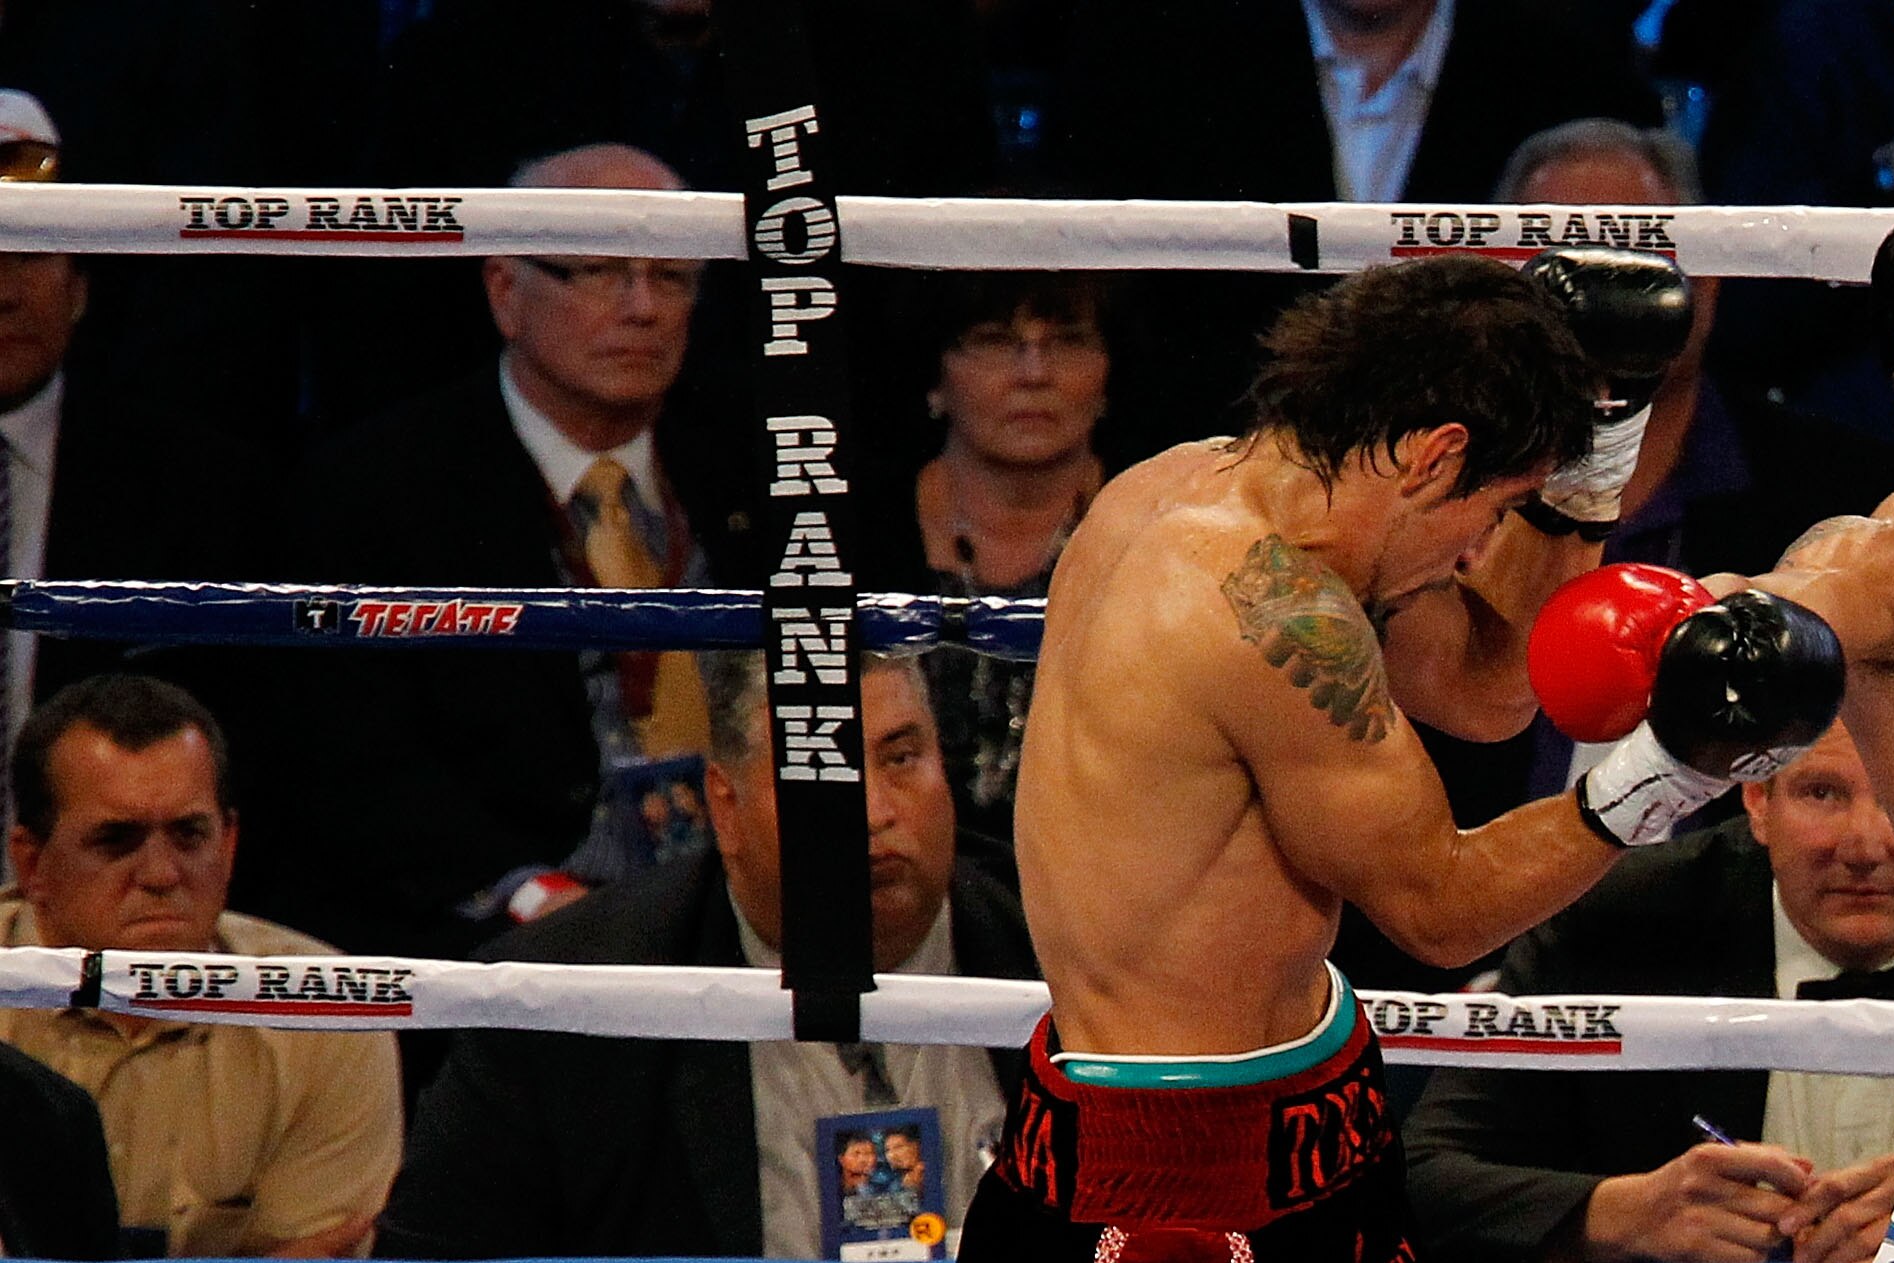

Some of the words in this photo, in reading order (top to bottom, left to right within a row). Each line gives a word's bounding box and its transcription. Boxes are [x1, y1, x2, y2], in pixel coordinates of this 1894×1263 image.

[180, 197, 289, 231] TOP
[305, 198, 465, 233] RANK
[745, 105, 837, 356] TOP
[1391, 212, 1502, 248] TOP
[1518, 214, 1677, 250] RANK
[348, 599, 524, 638] TECATE
[766, 416, 860, 782] RANK
[130, 963, 241, 1000] TOP
[256, 966, 413, 1003] RANK
[1366, 1001, 1447, 1035] OP
[1464, 1003, 1622, 1039] RANK
